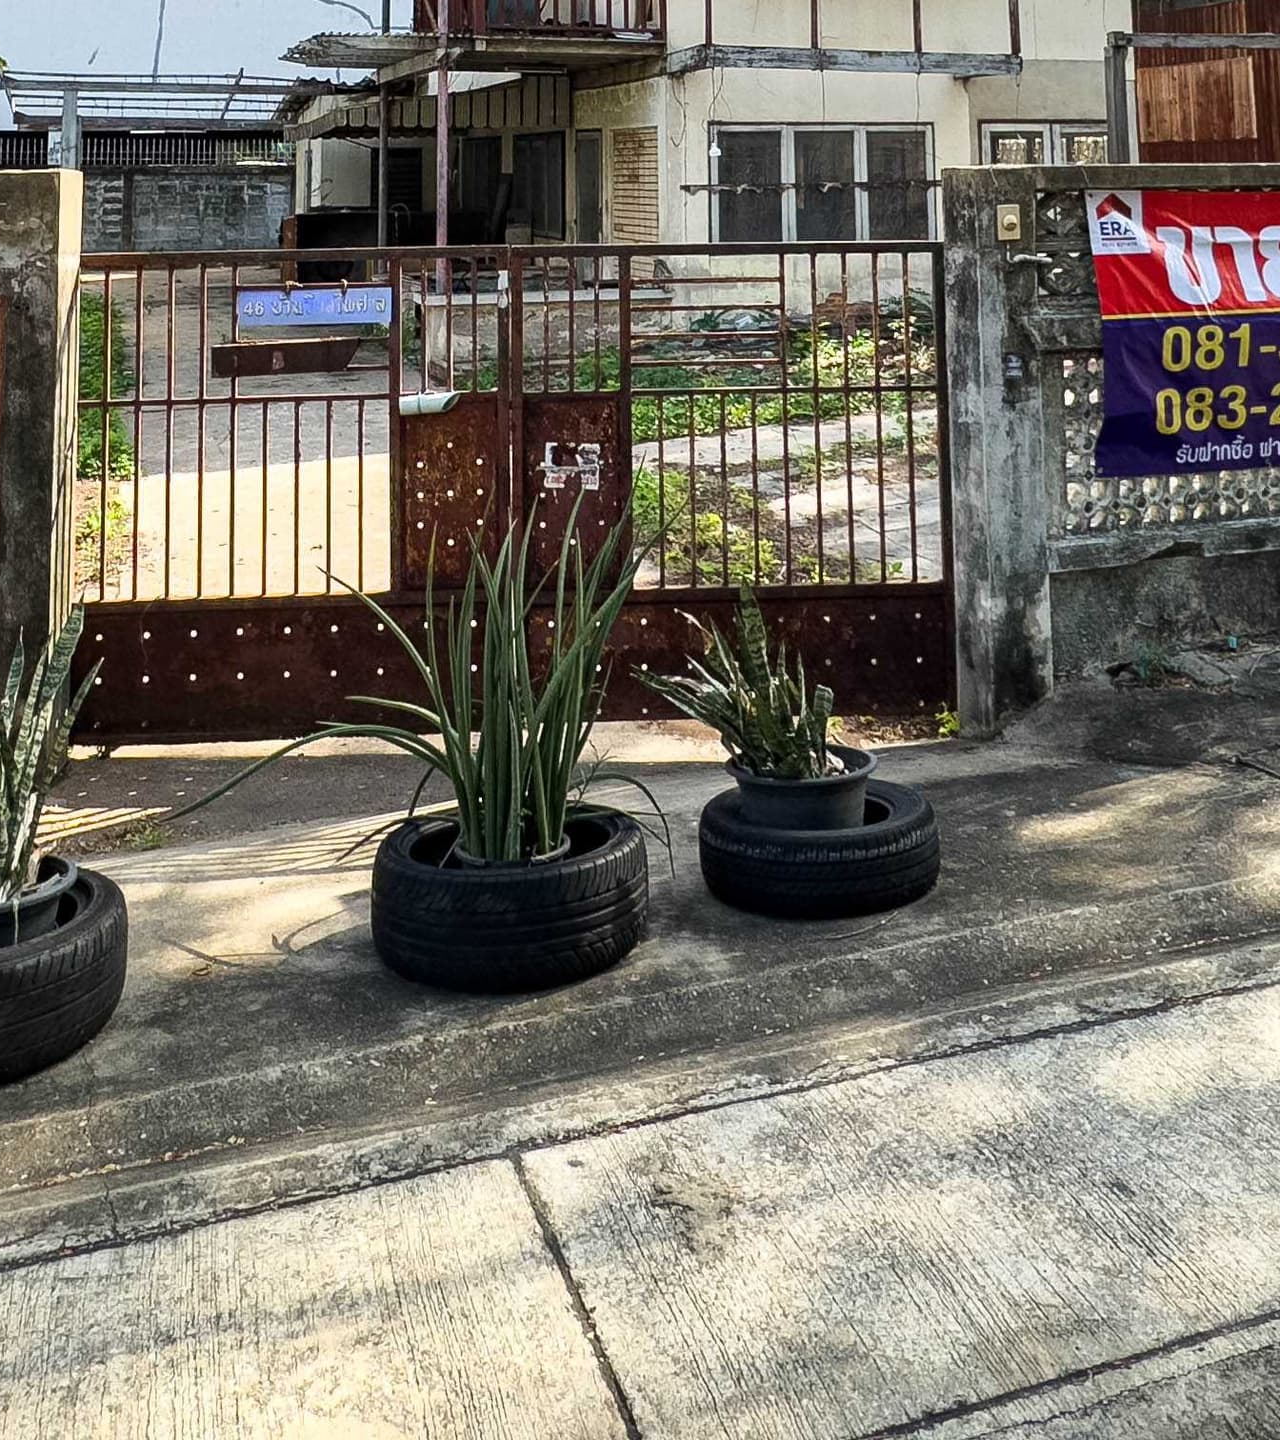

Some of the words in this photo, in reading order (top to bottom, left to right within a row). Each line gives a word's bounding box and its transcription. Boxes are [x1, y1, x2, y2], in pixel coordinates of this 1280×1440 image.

[1099, 221, 1135, 236] ERA
[1176, 435, 1253, 464] รับฝากซื้อ
